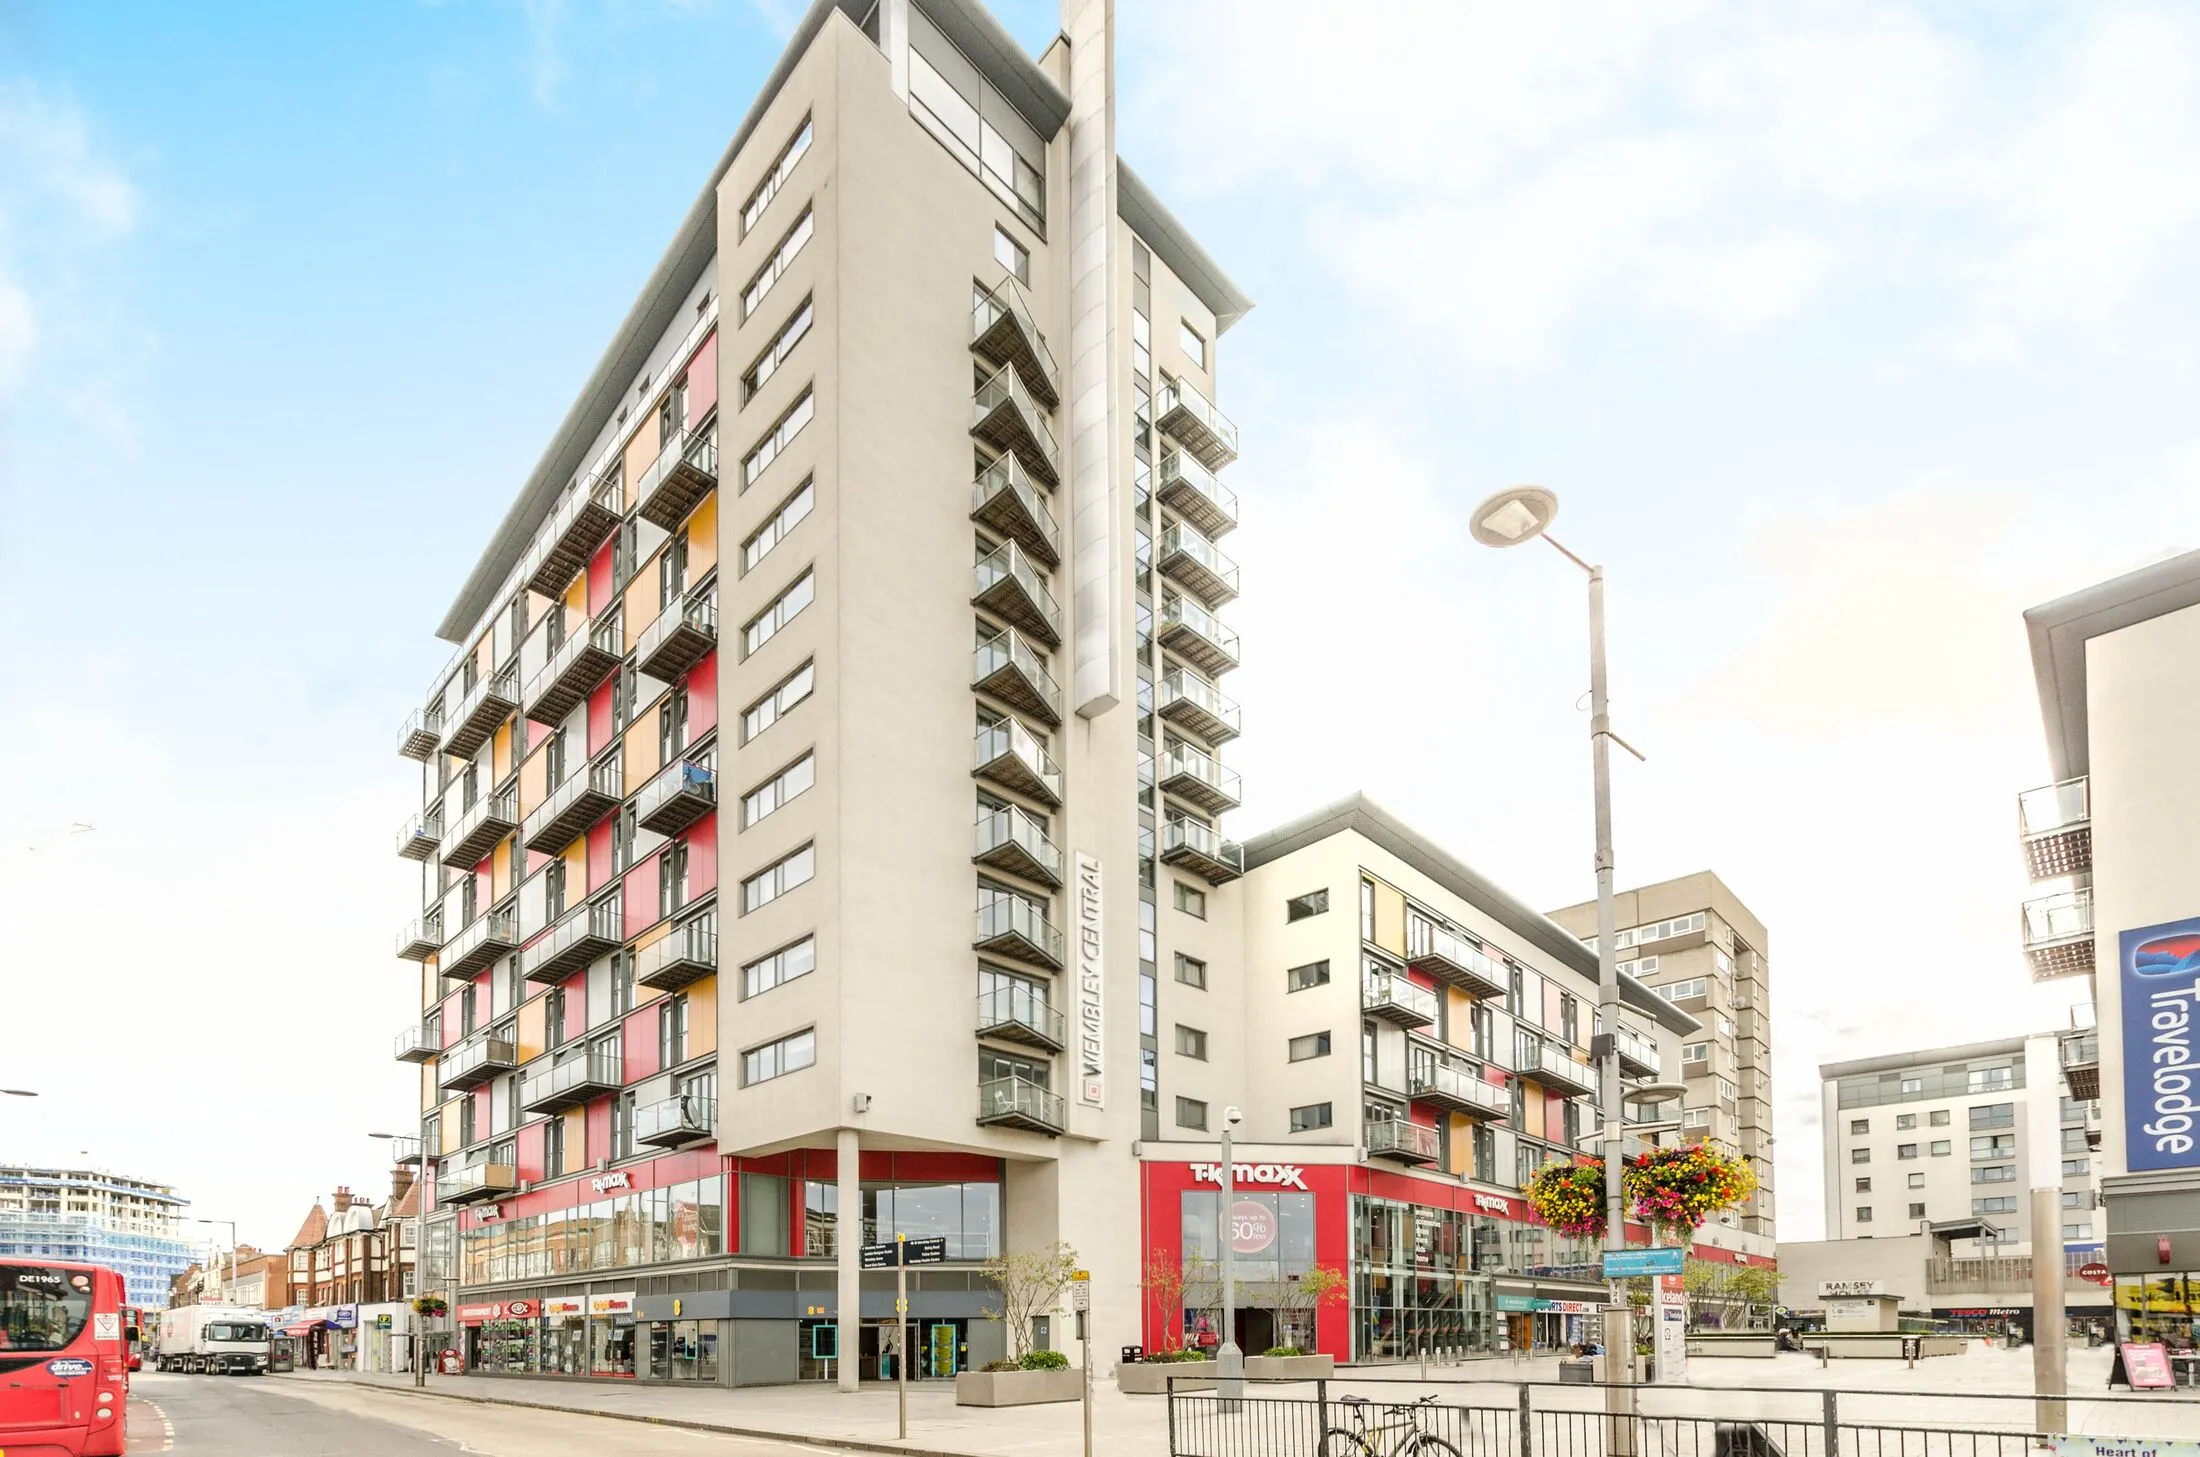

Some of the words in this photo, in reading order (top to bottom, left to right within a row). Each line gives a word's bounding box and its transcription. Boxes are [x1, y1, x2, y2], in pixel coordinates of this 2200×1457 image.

[1081, 860, 1100, 961] CENTRAL
[1082, 963, 1102, 1078] WEMBLEY
[2143, 978, 2200, 1154] Travelodge
[19, 1275, 60, 1283] DE1965
[1661, 1290, 1683, 1304] Iceland
[2096, 1446, 2136, 1457] Heart
[2142, 1448, 2157, 1457] of
